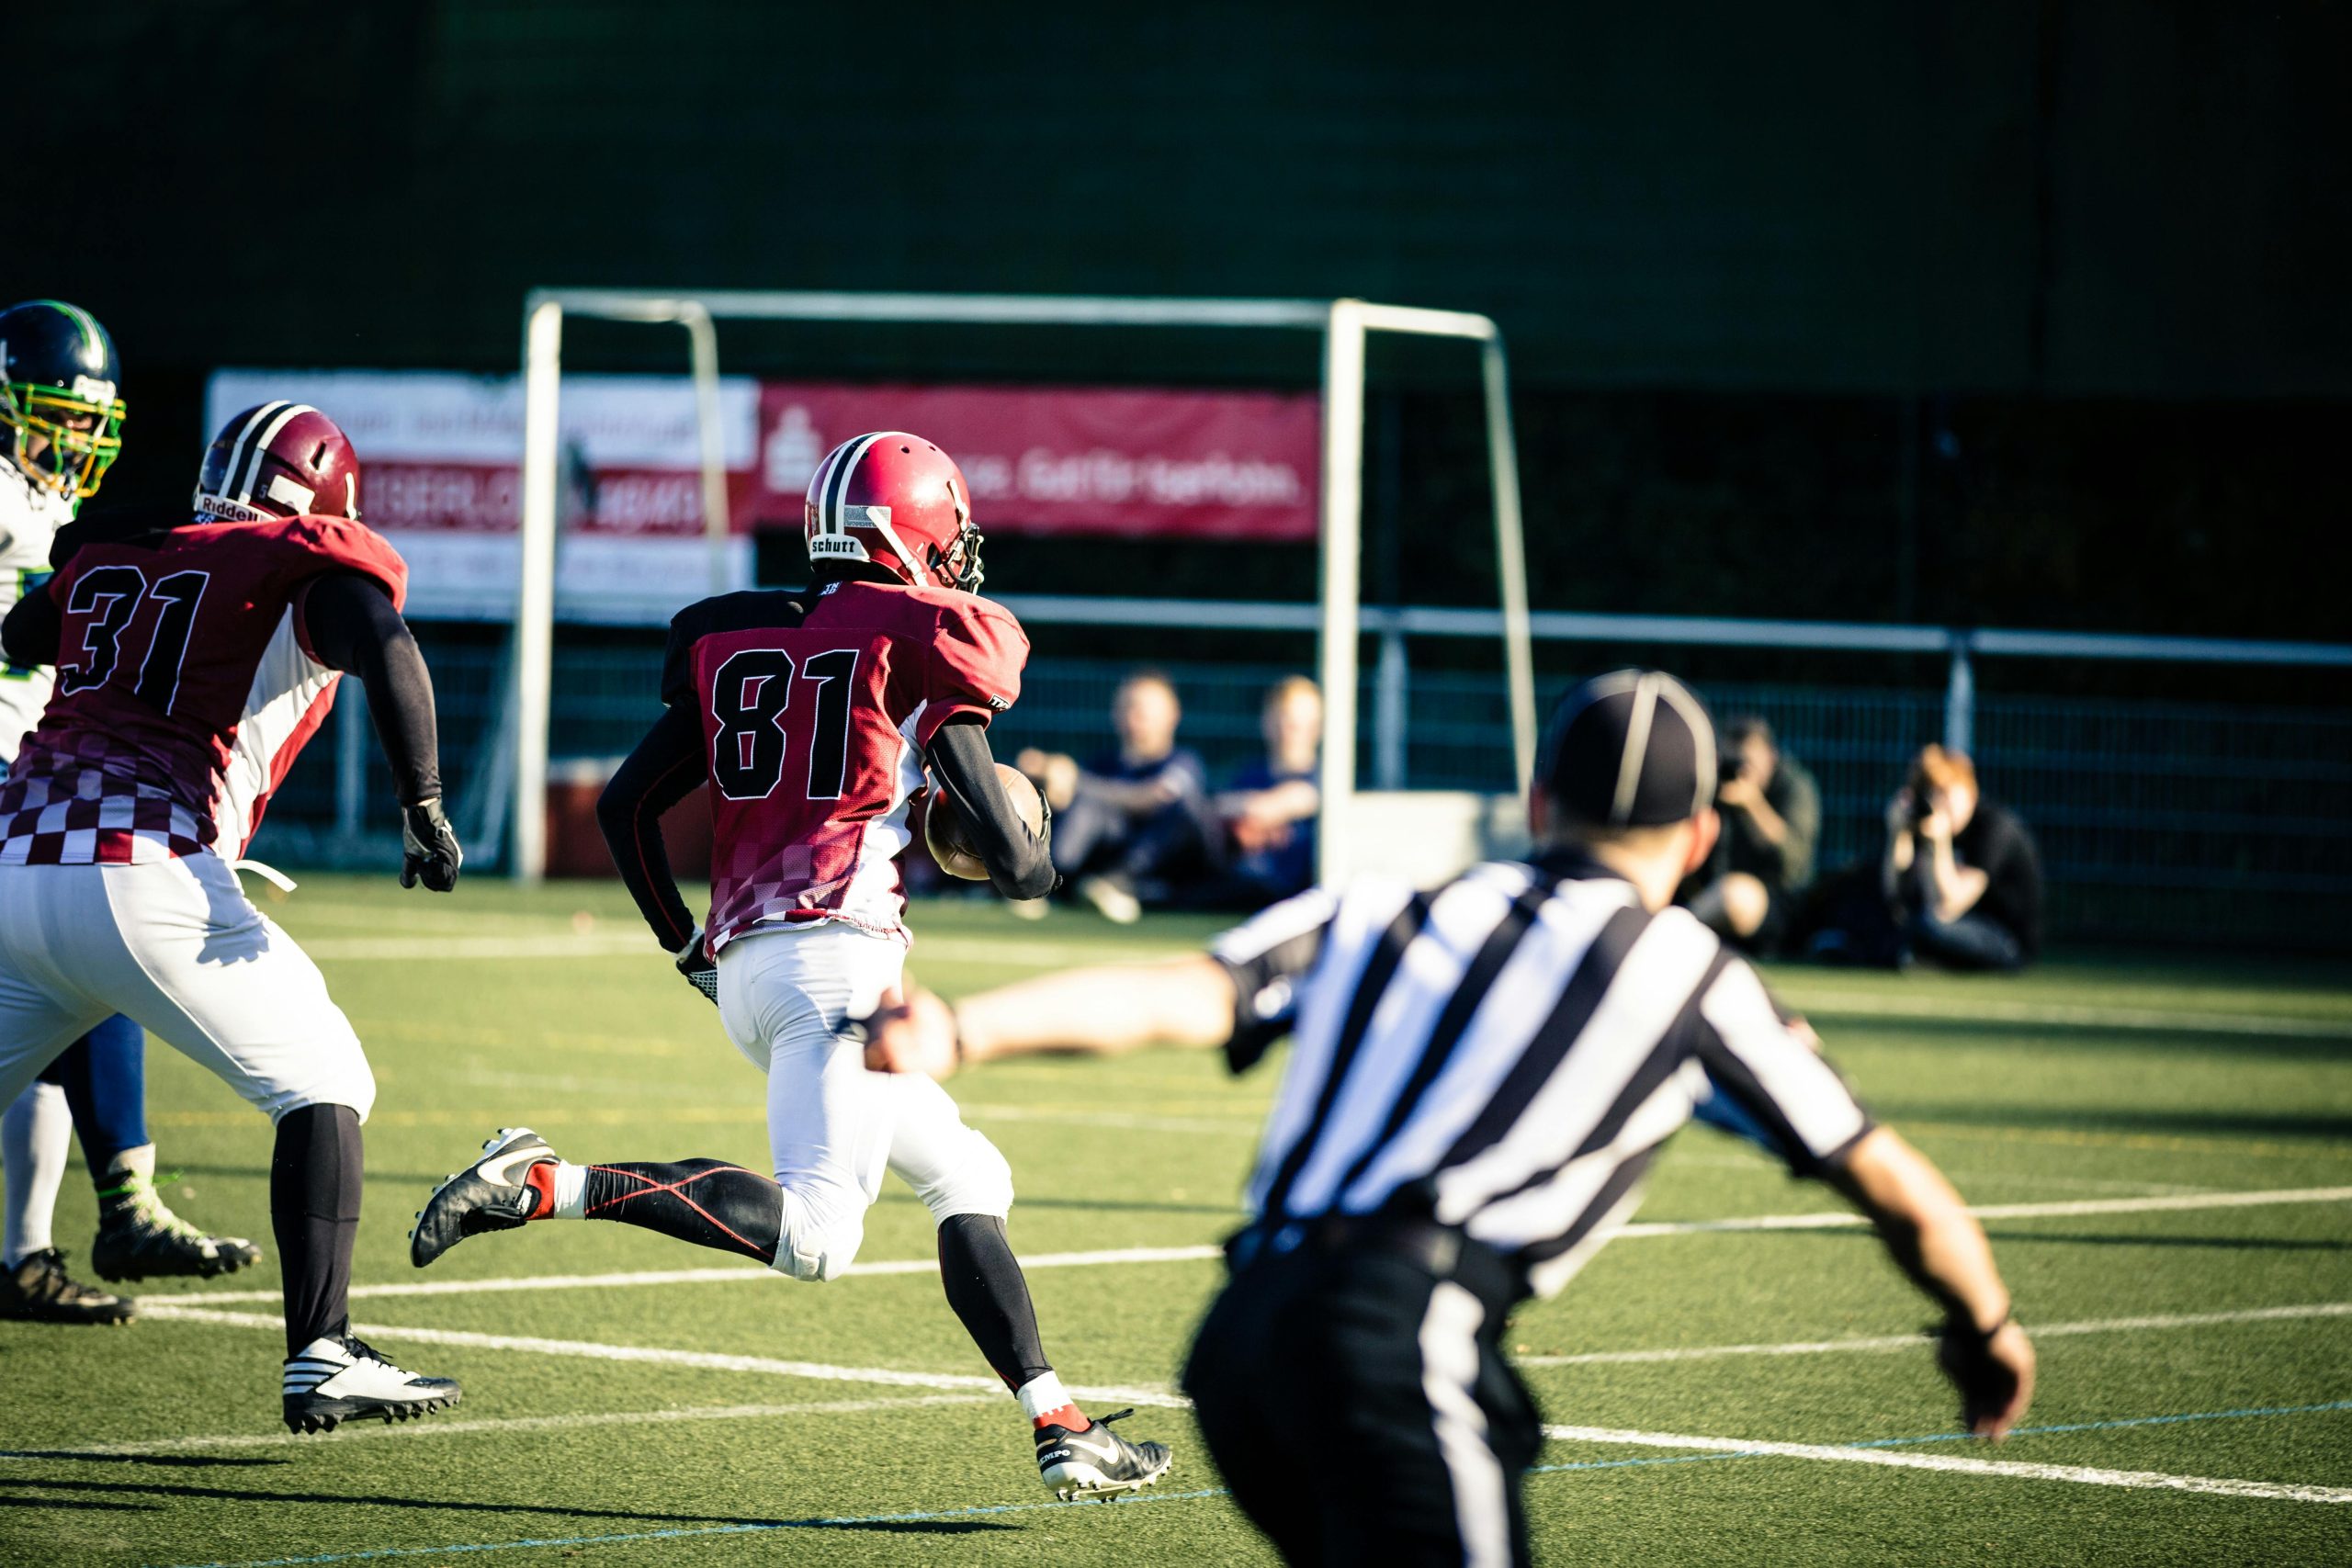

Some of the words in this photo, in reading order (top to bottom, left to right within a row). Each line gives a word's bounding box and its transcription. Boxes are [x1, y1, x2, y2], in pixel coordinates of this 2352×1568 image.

[203, 497, 258, 522] Riddell
[812, 537, 855, 553] schutt
[60, 565, 210, 716] 31
[712, 649, 860, 801] 81
[1039, 1449, 1071, 1466] EMPO
